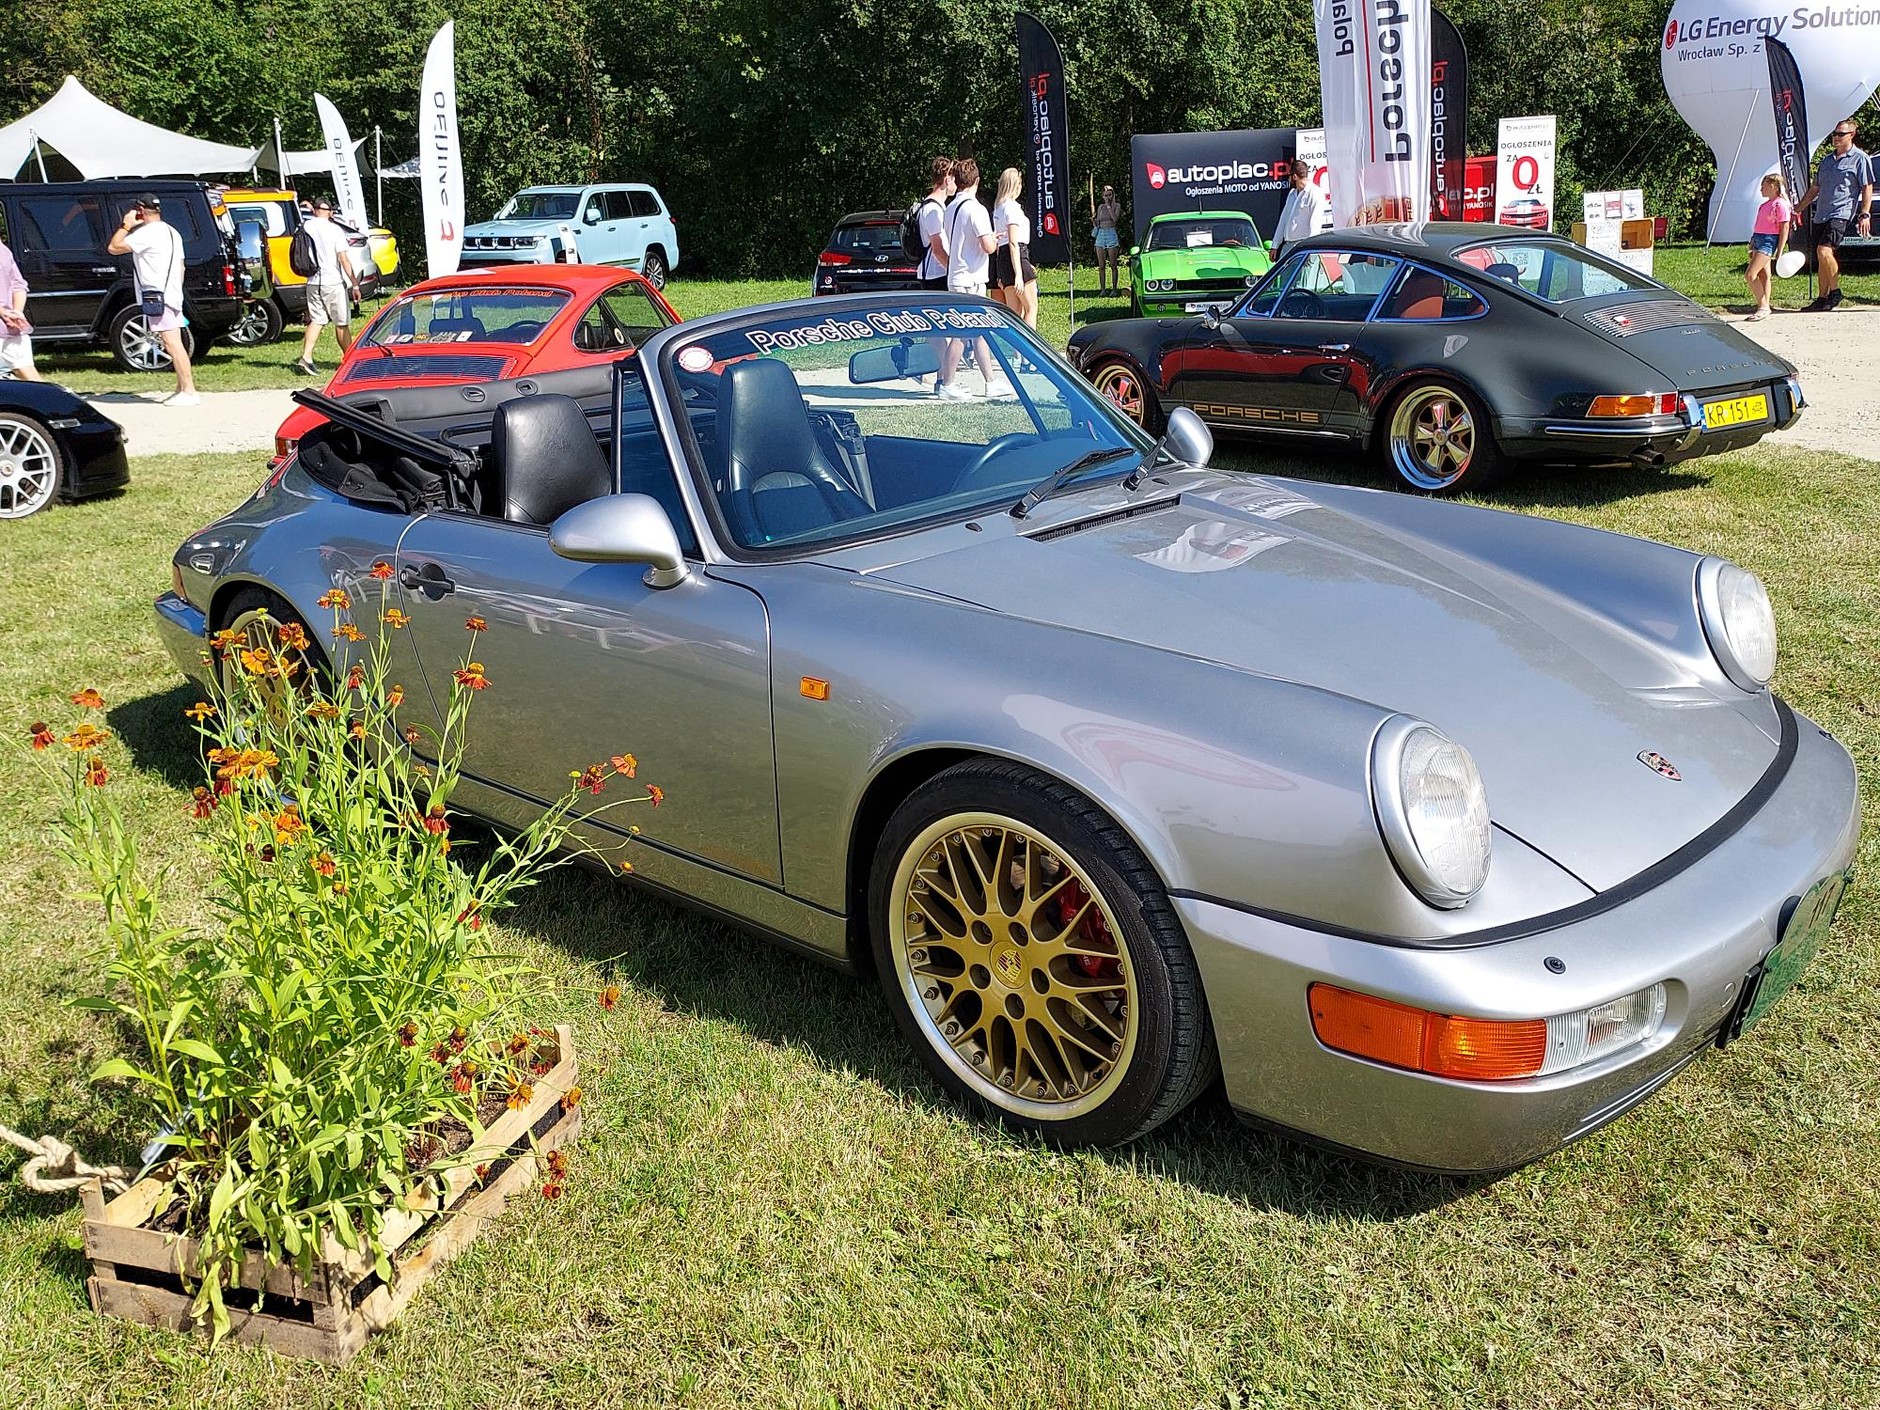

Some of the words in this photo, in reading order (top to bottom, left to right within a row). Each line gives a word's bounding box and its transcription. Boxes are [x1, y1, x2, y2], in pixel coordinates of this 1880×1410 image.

[1678, 19, 1702, 43] LG
[1705, 14, 1788, 40] Energy
[1677, 46, 1724, 62] Wrocław
[1728, 43, 1748, 58] Sp.
[1753, 43, 1761, 53] z
[1500, 140, 1552, 149] OGŁOSZENIA
[1299, 151, 1327, 160] OGŁOS
[1167, 158, 1292, 185] autoplac.p
[1224, 183, 1247, 193] MOTO
[1248, 182, 1259, 192] od
[1259, 180, 1290, 190] YANOSI
[1527, 183, 1543, 195] ZŁ
[746, 319, 873, 355] Porsche
[866, 312, 931, 335] Club
[922, 308, 1006, 330] Poland
[1193, 403, 1319, 424] PORSCHE
[1707, 404, 1726, 425] KR
[1730, 400, 1750, 422] 151
